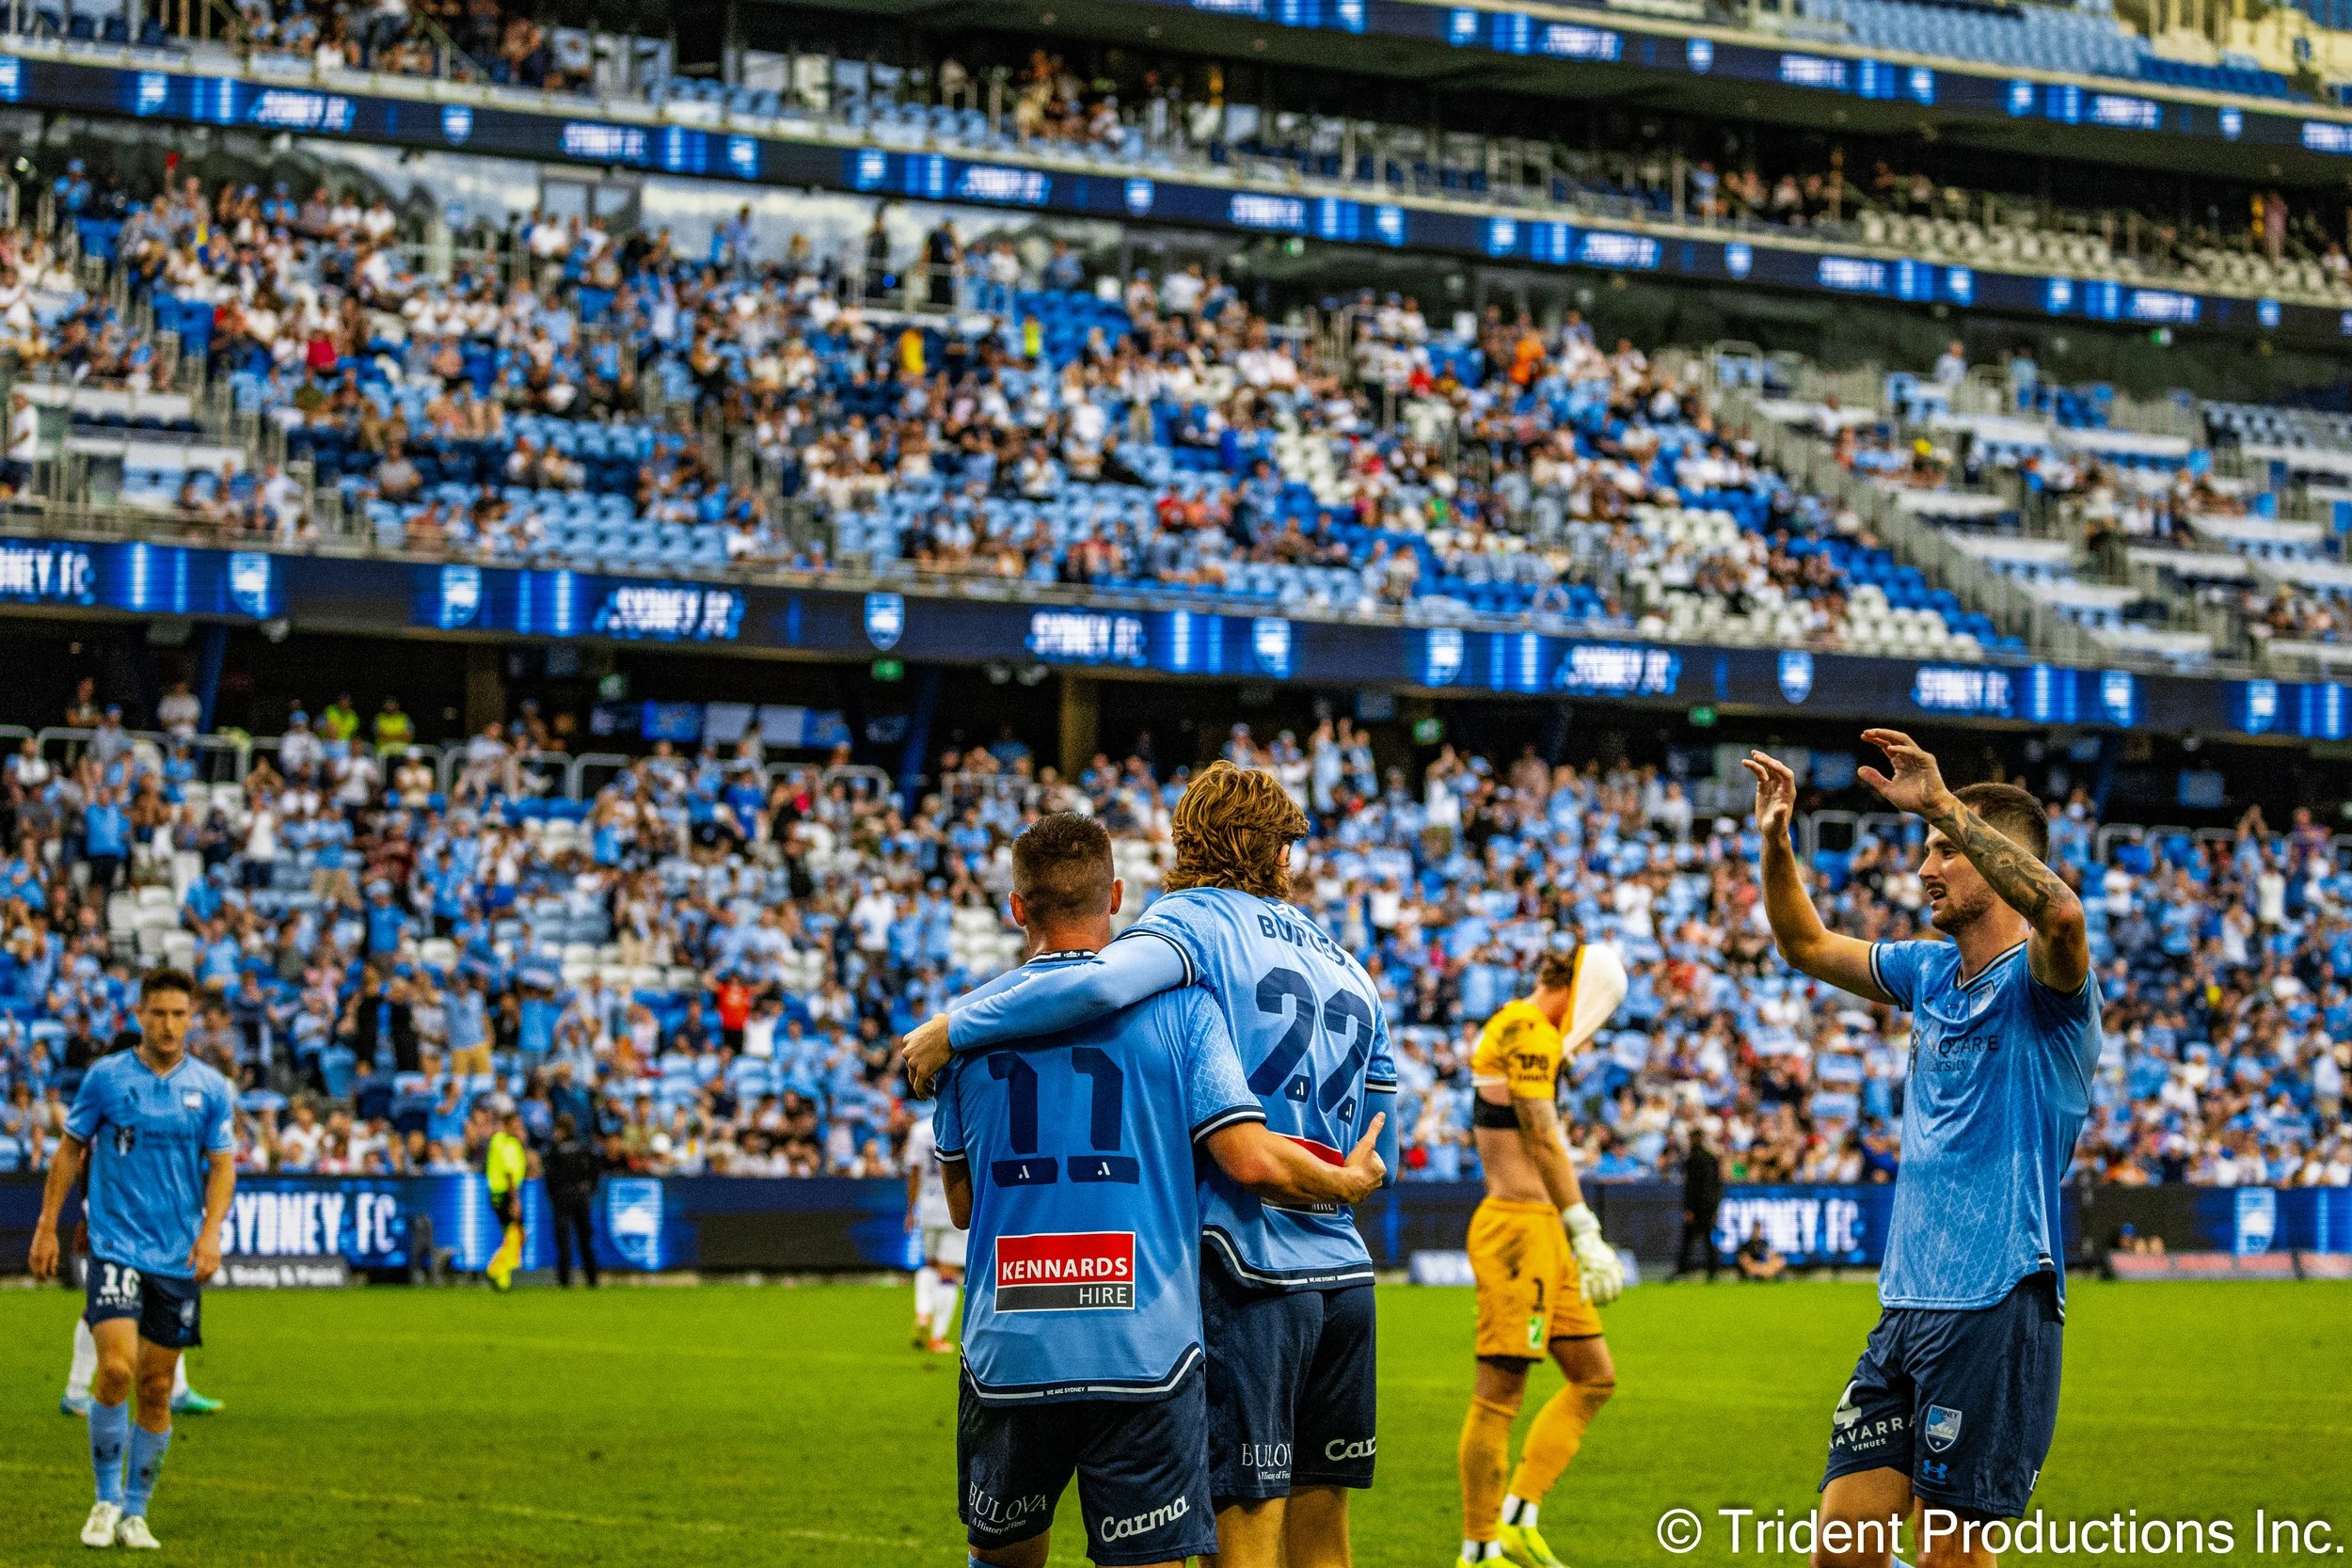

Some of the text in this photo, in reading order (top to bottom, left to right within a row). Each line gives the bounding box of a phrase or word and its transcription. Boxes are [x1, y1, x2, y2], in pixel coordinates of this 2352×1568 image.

[1247, 966, 1374, 1127] 22
[987, 1046, 1140, 1188] 11
[220, 1191, 396, 1255] SYDNEY FC
[1824, 1198, 1859, 1254] FC
[100, 1262, 141, 1298] 16
[1002, 1257, 1128, 1280] KENNARDS
[1079, 1287, 1127, 1305] HIRE
[1851, 1437, 1886, 1451] VENUES
[969, 1481, 1047, 1523] BULOVA
[1101, 1496, 1190, 1543] Carma
[977, 1520, 1003, 1535] History
